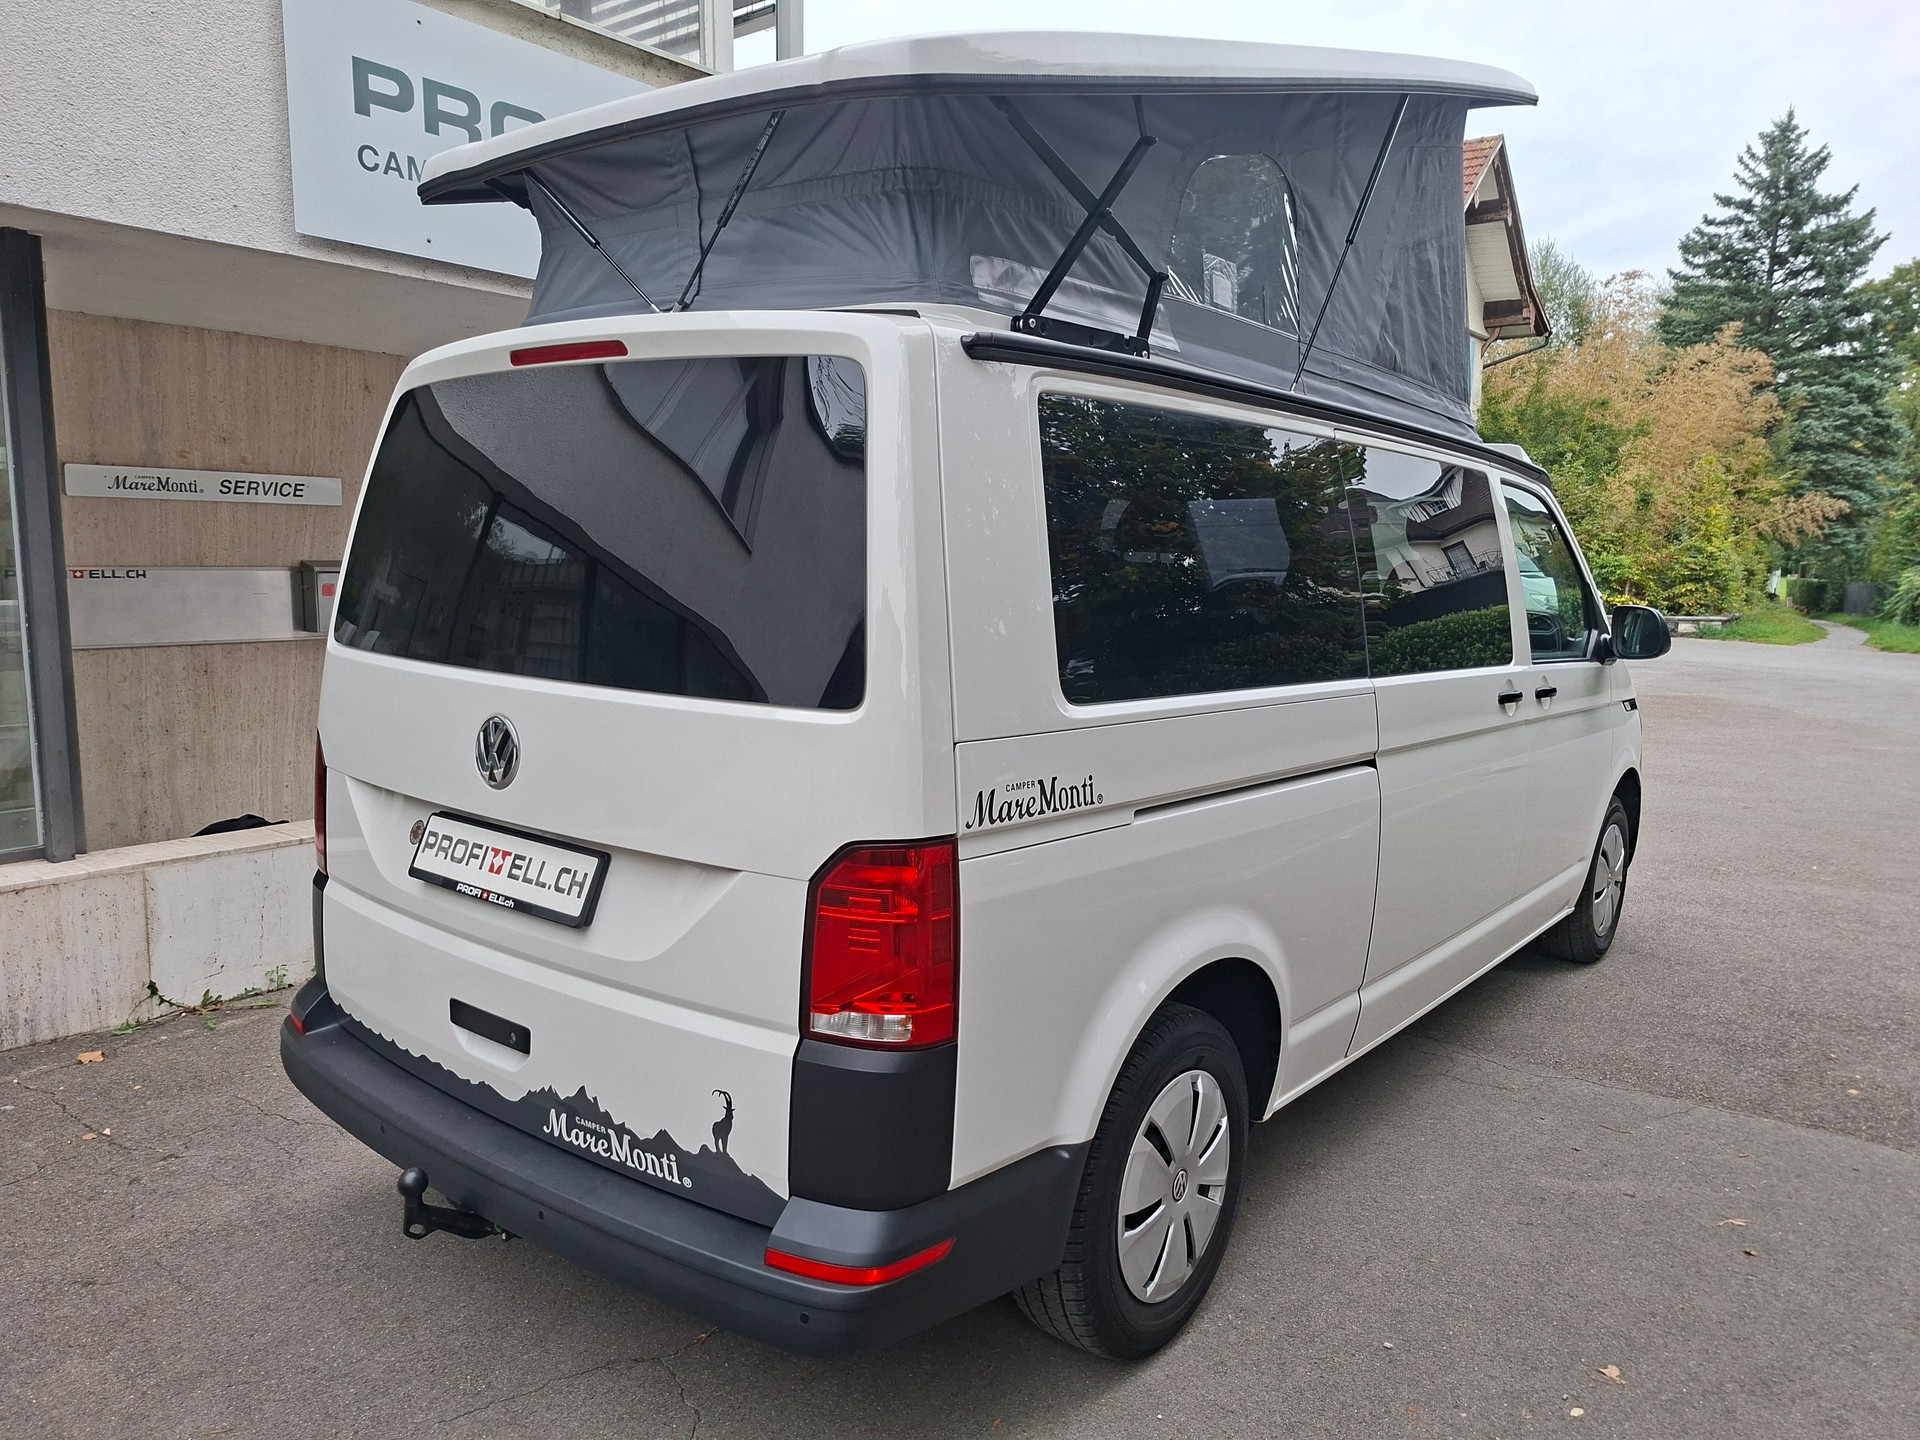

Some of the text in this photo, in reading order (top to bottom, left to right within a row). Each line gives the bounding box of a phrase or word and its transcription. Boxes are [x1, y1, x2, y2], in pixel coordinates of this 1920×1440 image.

[218, 479, 305, 498] SERVICE
[1005, 780, 1036, 793] CAMPER
[575, 1116, 607, 1135] CAMPER
